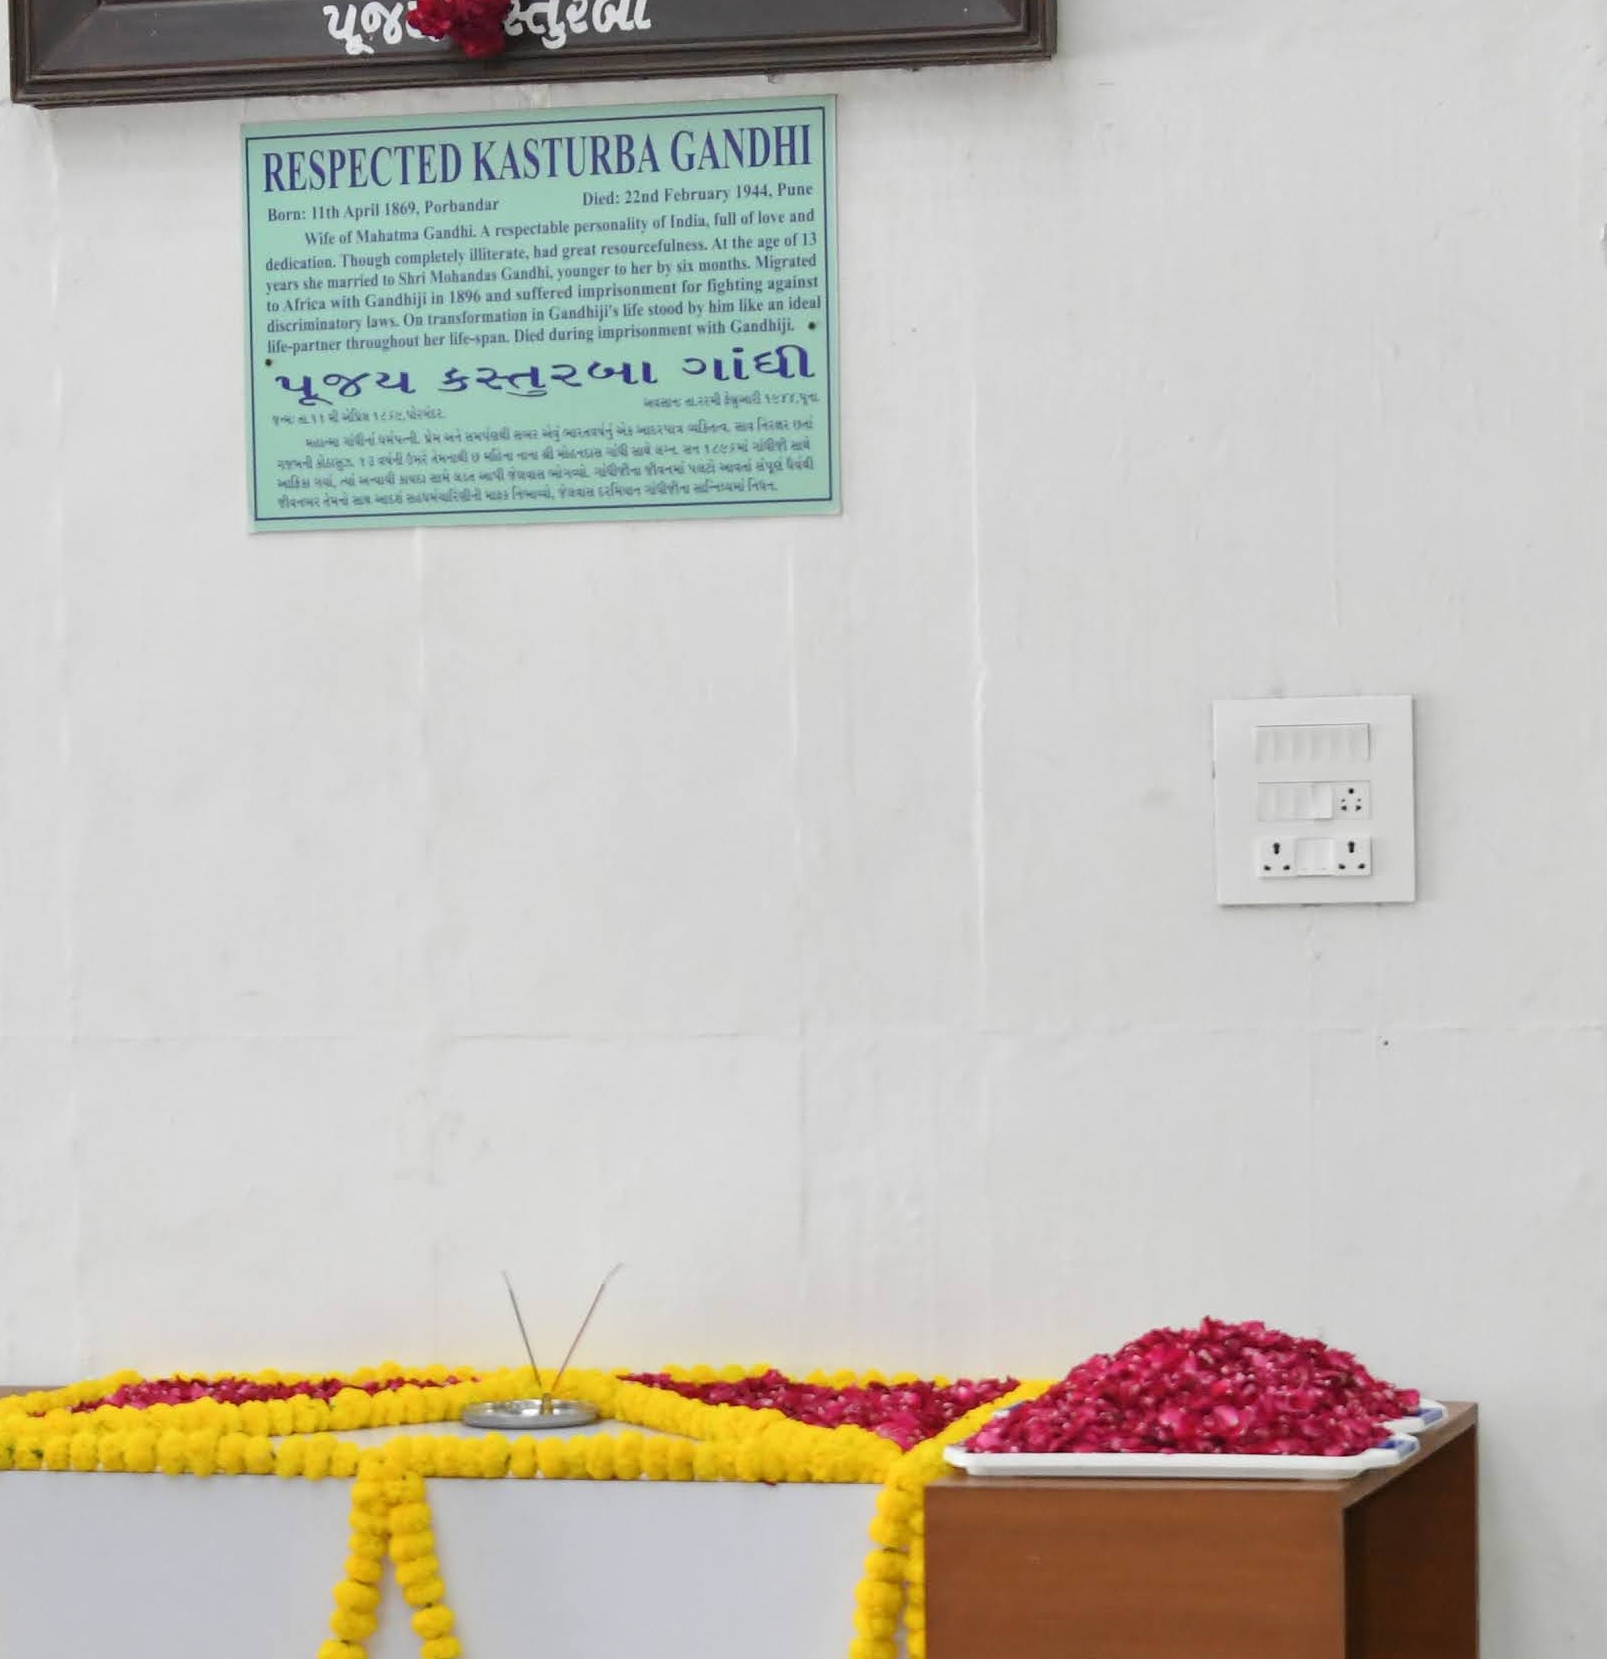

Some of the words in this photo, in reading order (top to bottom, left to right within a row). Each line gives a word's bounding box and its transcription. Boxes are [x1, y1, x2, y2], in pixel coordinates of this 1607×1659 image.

[262, 142, 462, 194] RESPECTED
[471, 133, 661, 182] KASTURBA
[670, 123, 813, 173] GANDHI
[266, 206, 308, 224] Born:
[311, 203, 341, 222] 11th
[342, 201, 381, 224] April
[423, 196, 501, 216] Porbandar
[581, 189, 621, 208] Died:
[623, 187, 660, 206] 22nd
[663, 186, 732, 205] February
[776, 180, 815, 198] Pune
[303, 230, 337, 247] Wife
[337, 228, 354, 246] of
[355, 227, 420, 246] Mahatma
[479, 223, 492, 239] A
[494, 218, 571, 241] respectable
[572, 215, 648, 238] personality
[651, 213, 668, 231] of
[713, 210, 738, 228] full
[739, 209, 756, 227] of
[756, 208, 786, 226] love
[788, 206, 816, 224] and
[339, 250, 392, 271] Though
[393, 247, 465, 269] completely
[532, 242, 559, 260] had
[560, 243, 598, 262] great
[711, 236, 729, 252] At
[731, 234, 754, 251] the
[756, 236, 781, 253] age
[782, 231, 800, 248] of
[801, 230, 818, 248] 13
[264, 279, 300, 297] years
[301, 275, 325, 291] she
[326, 272, 380, 290] married
[381, 273, 396, 288] to
[397, 270, 427, 286] Shri
[429, 267, 499, 285] Mohandas
[556, 264, 612, 283] younger
[613, 263, 628, 277] to
[629, 259, 654, 276] her
[655, 258, 672, 279] by
[675, 258, 695, 275] six
[754, 251, 818, 274] Migrated
[265, 299, 281, 314] to
[282, 296, 328, 313] Africa
[329, 293, 362, 310] with
[363, 290, 428, 311] Gandhiji
[430, 290, 445, 306] in
[449, 288, 483, 306] 1896
[484, 286, 513, 304] and
[514, 283, 574, 302] suffered
[576, 282, 678, 303] imprisonment
[680, 278, 704, 295] for
[706, 276, 764, 297] fighting
[766, 274, 820, 295] against
[265, 315, 363, 334] discriminatory
[401, 312, 425, 329] On
[426, 307, 529, 327] transformation
[530, 306, 546, 323] in
[547, 303, 620, 324] Gandhiji's
[621, 301, 645, 318] life
[646, 299, 685, 318] stood
[686, 299, 705, 319] by
[707, 298, 736, 315] him
[737, 296, 765, 314] like
[766, 299, 785, 313] an
[787, 293, 823, 312] ideal
[266, 338, 344, 358] life-partner
[344, 333, 420, 354] throughout
[422, 331, 447, 348] her
[513, 326, 546, 344] Died
[547, 325, 595, 345] during
[596, 322, 693, 344] imprisonment
[695, 319, 727, 336] with
